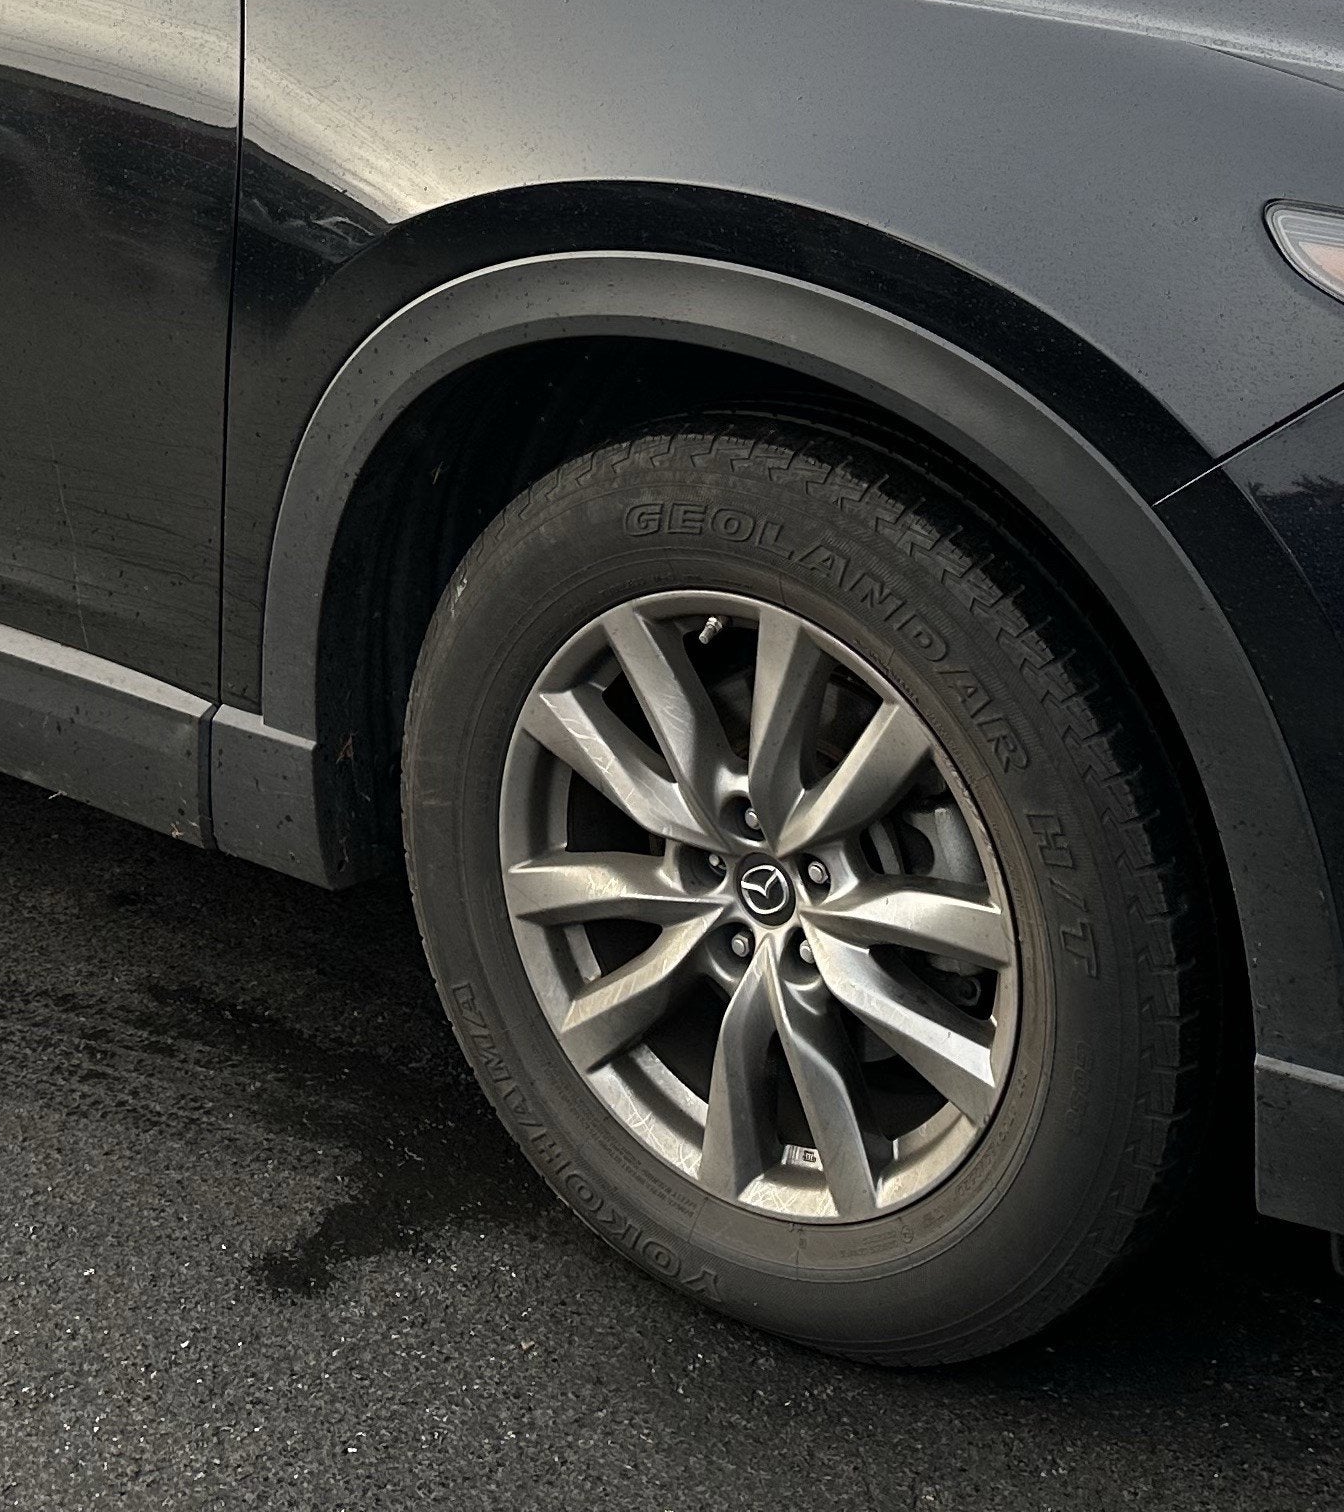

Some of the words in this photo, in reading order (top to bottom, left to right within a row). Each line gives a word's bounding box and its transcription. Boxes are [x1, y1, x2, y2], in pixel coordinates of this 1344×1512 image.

[620, 501, 1032, 776] GEOLANDAR
[1025, 806, 1100, 979] H/T
[448, 979, 723, 1301] YOKOHAMA
